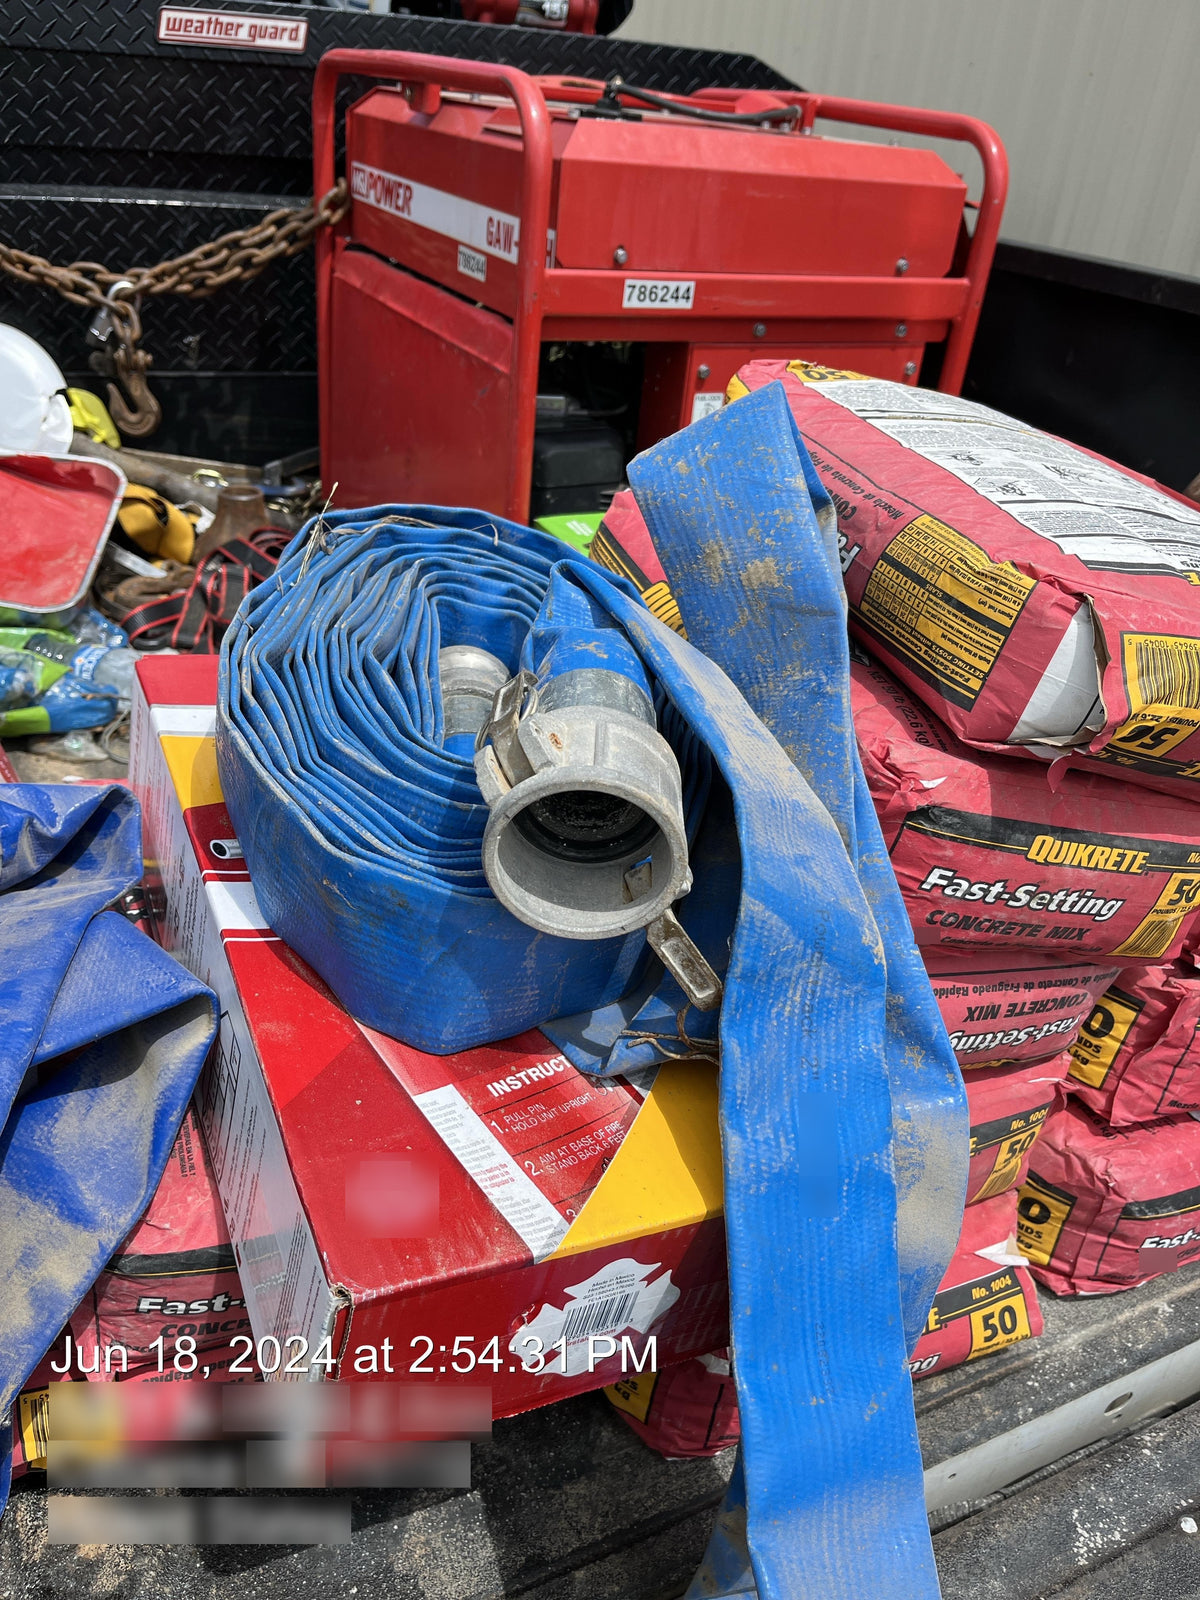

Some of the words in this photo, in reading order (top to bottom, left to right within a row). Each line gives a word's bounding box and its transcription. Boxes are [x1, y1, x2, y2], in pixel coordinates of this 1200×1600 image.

[165, 16, 244, 38] weather
[249, 24, 299, 44] guard
[368, 173, 414, 216] POWER
[626, 284, 692, 303] 786244
[821, 464, 833, 473] de
[831, 470, 866, 495] Concreto
[862, 493, 876, 502] de
[873, 498, 905, 520] Mezcla
[914, 541, 921, 549] 14
[902, 556, 910, 564] 15
[910, 561, 919, 570] 10
[885, 567, 892, 575] 7
[919, 567, 926, 575] 5
[923, 582, 944, 598] SLABS
[996, 607, 1014, 621] Square
[892, 628, 925, 653] Concrete
[910, 628, 933, 647] without
[1143, 640, 1169, 649] 10045
[1174, 642, 1198, 651] 39645
[930, 643, 953, 660] POSTS
[920, 648, 972, 684] Fast-Setting
[951, 655, 985, 680] SETTING
[896, 704, 923, 729] (22.6
[914, 731, 936, 748] kg)
[1169, 716, 1200, 728] POUNDS
[1117, 725, 1180, 750] 50
[1027, 834, 1149, 874] QUIKRETE
[919, 865, 1127, 922] Fast-Setting
[926, 910, 1043, 939] CONCRETE
[1044, 926, 1091, 942] MIX
[972, 981, 1020, 997] Fraguado
[1023, 981, 1035, 990] de
[1038, 976, 1079, 989] Concreto
[1081, 974, 1092, 985] de
[933, 985, 969, 1000] Rápido
[962, 1003, 1001, 1023] MIX
[1003, 991, 1089, 1018] CONCRETE
[1082, 1004, 1115, 1038] 0
[486, 1055, 572, 1098] INSTRUCT
[510, 1117, 539, 1134] HOLD
[538, 1108, 559, 1124] UNIT
[557, 1092, 597, 1114] UPRIGHT.
[1167, 1100, 1200, 1110] Mezcl
[490, 1119, 509, 1135] 1.
[503, 1110, 530, 1125] PULL
[530, 1101, 549, 1116] PIN.
[1010, 1119, 1026, 1131] No.
[524, 1159, 544, 1177] 2.
[538, 1151, 559, 1166] AIM
[556, 1144, 572, 1158] AT
[568, 1134, 596, 1151] BASE
[593, 1128, 608, 1141] OF
[1003, 1131, 1037, 1164] 50
[545, 1156, 580, 1175] STAND
[578, 1144, 606, 1161] BACK
[603, 1140, 611, 1150] 6
[1018, 1196, 1051, 1225] 0
[1016, 1221, 1043, 1240] NDS
[588, 1283, 607, 1294] Hecho
[592, 1279, 609, 1288] Made
[615, 1273, 636, 1281] Mexico
[972, 1286, 988, 1300] No.
[991, 1274, 1012, 1293] 1004
[982, 1305, 1018, 1343] 50
